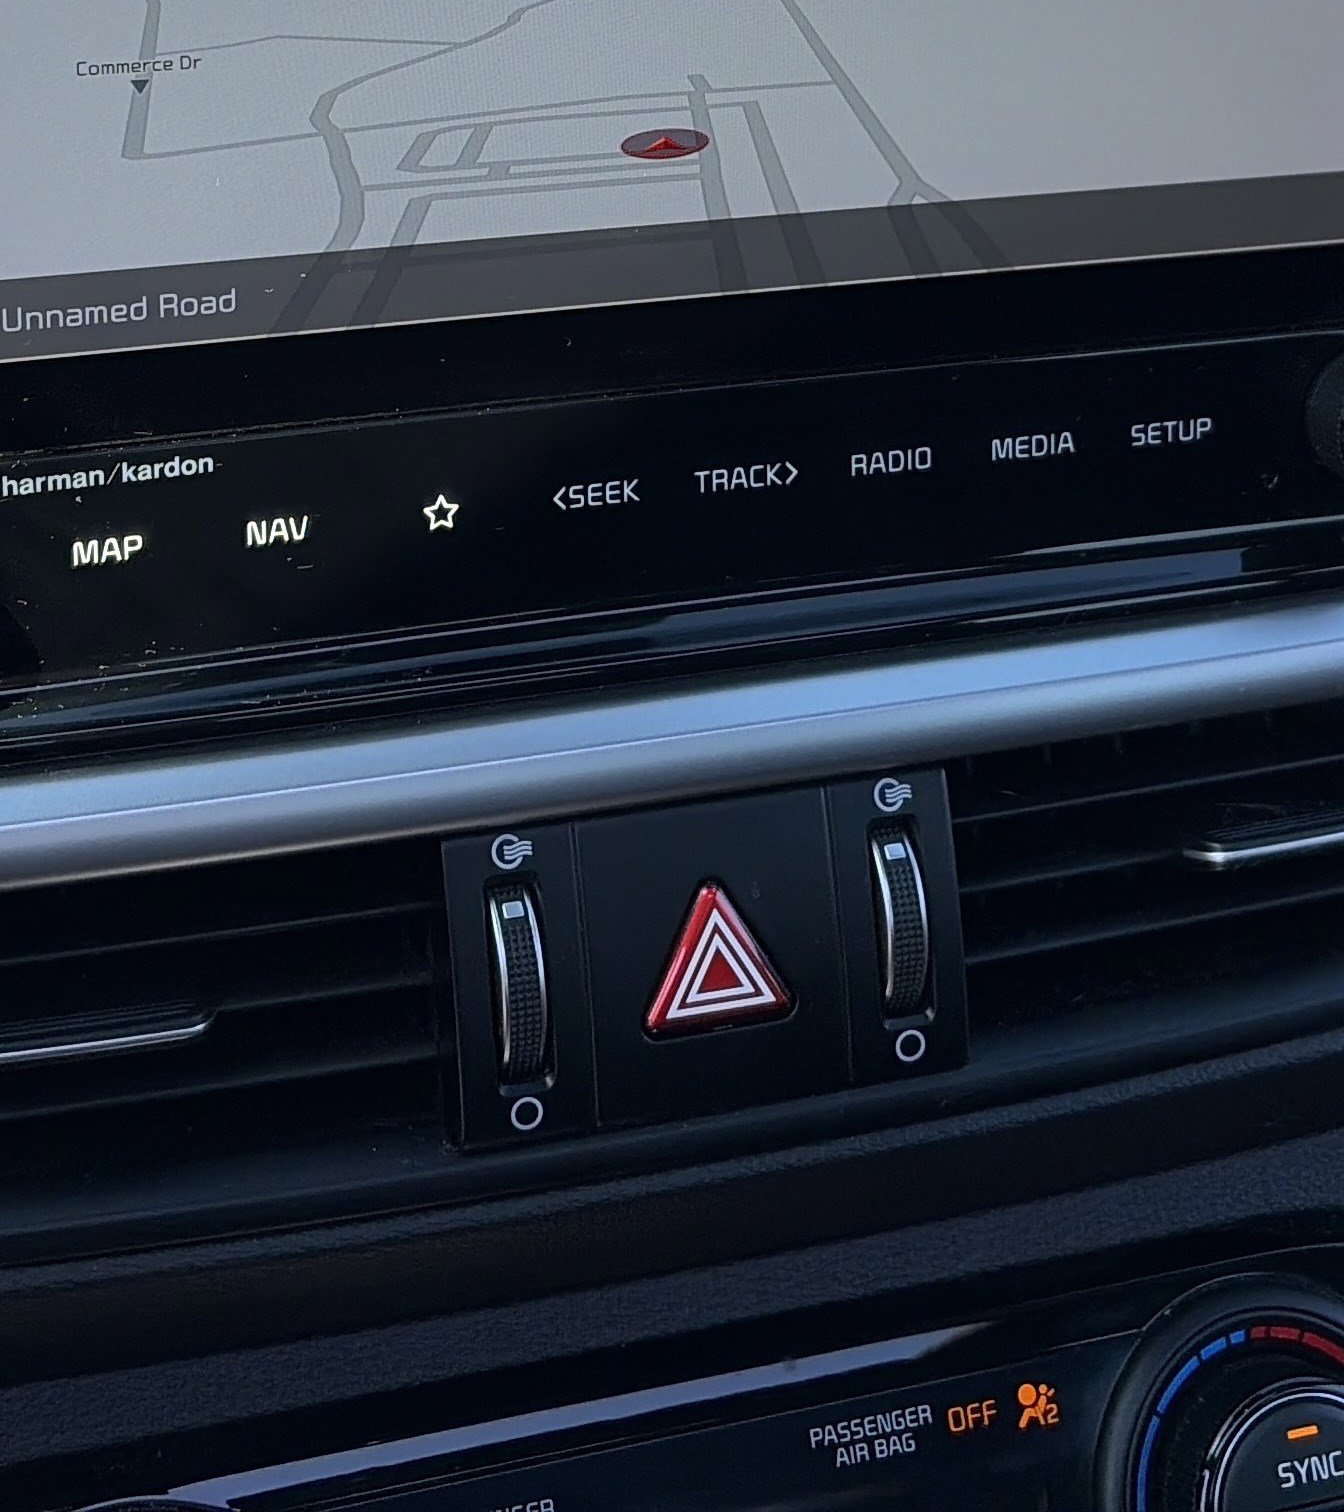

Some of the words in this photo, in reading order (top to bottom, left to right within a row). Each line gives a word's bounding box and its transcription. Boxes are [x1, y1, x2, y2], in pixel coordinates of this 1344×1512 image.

[76, 60, 174, 77] Commerce
[179, 54, 203, 71] Dr
[1, 295, 149, 333] Unnamed
[158, 287, 237, 319] Road
[991, 431, 1076, 462] MEDIA
[1130, 417, 1213, 447] SETUP
[1, 455, 215, 497] harman/kardon
[851, 446, 933, 477] RADIO
[246, 515, 309, 547] NAV
[72, 534, 143, 567] MAP
[808, 1403, 934, 1449] PASSENGER
[947, 1399, 998, 1433] OFF
[836, 1438, 871, 1468] AIR
[874, 1432, 917, 1459] BAG
